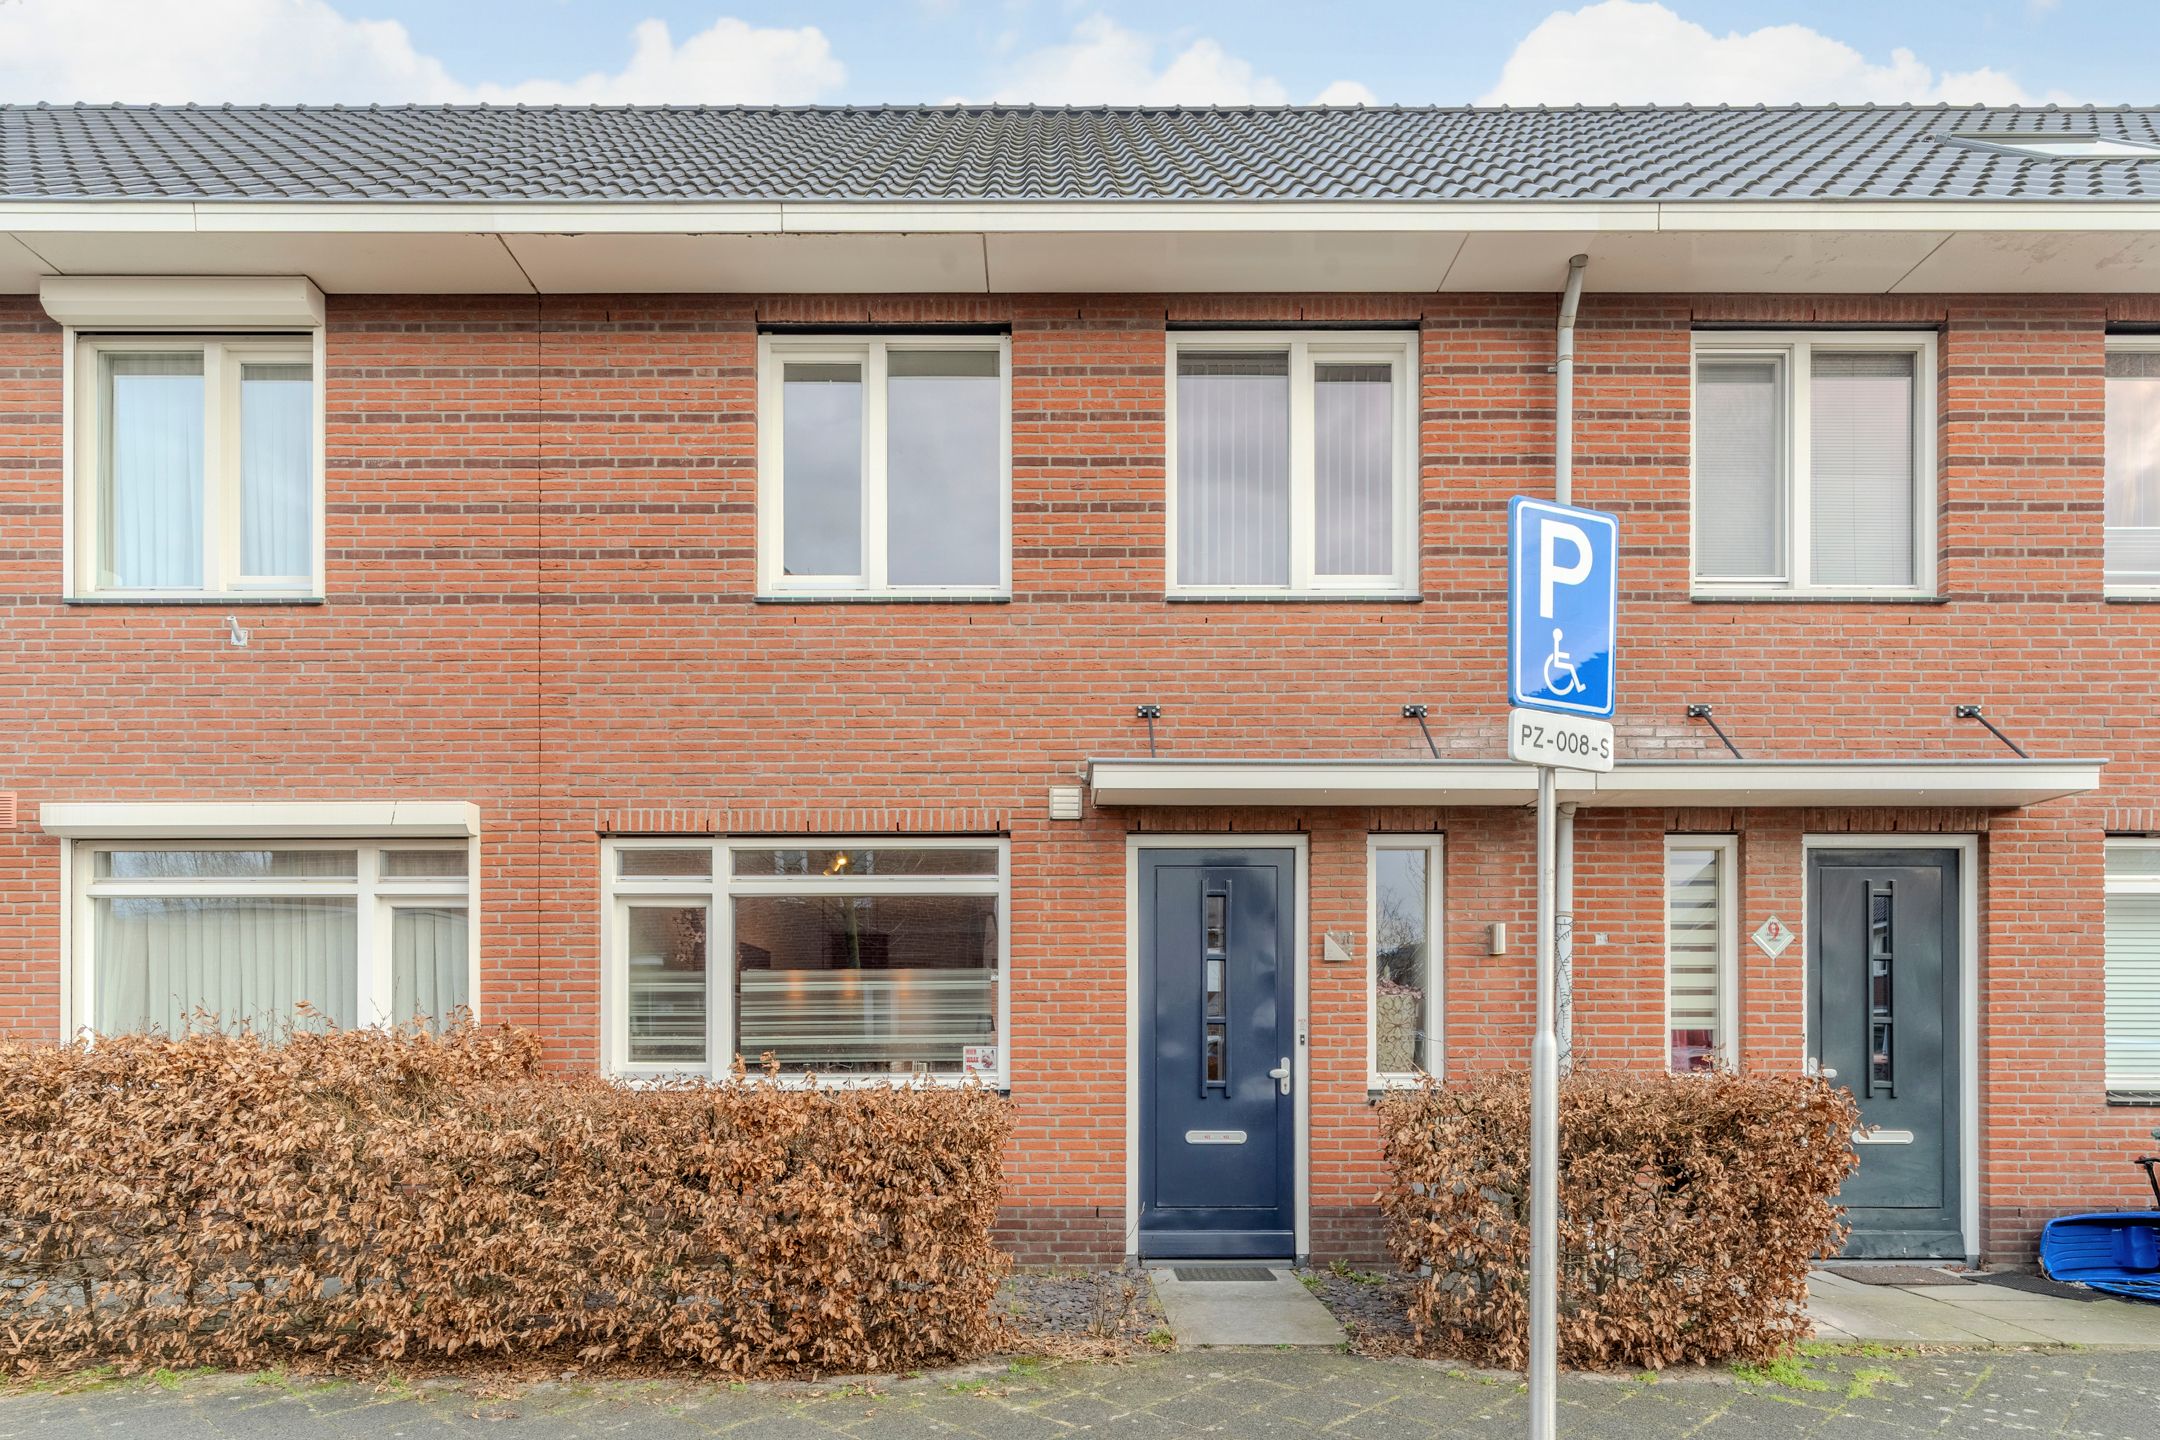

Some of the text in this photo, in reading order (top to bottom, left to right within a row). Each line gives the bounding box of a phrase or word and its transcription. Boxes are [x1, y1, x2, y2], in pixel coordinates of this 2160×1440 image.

[1540, 518, 1593, 619] P
[1521, 724, 1609, 759] PZ-008-S
[1768, 921, 1780, 940] 9
